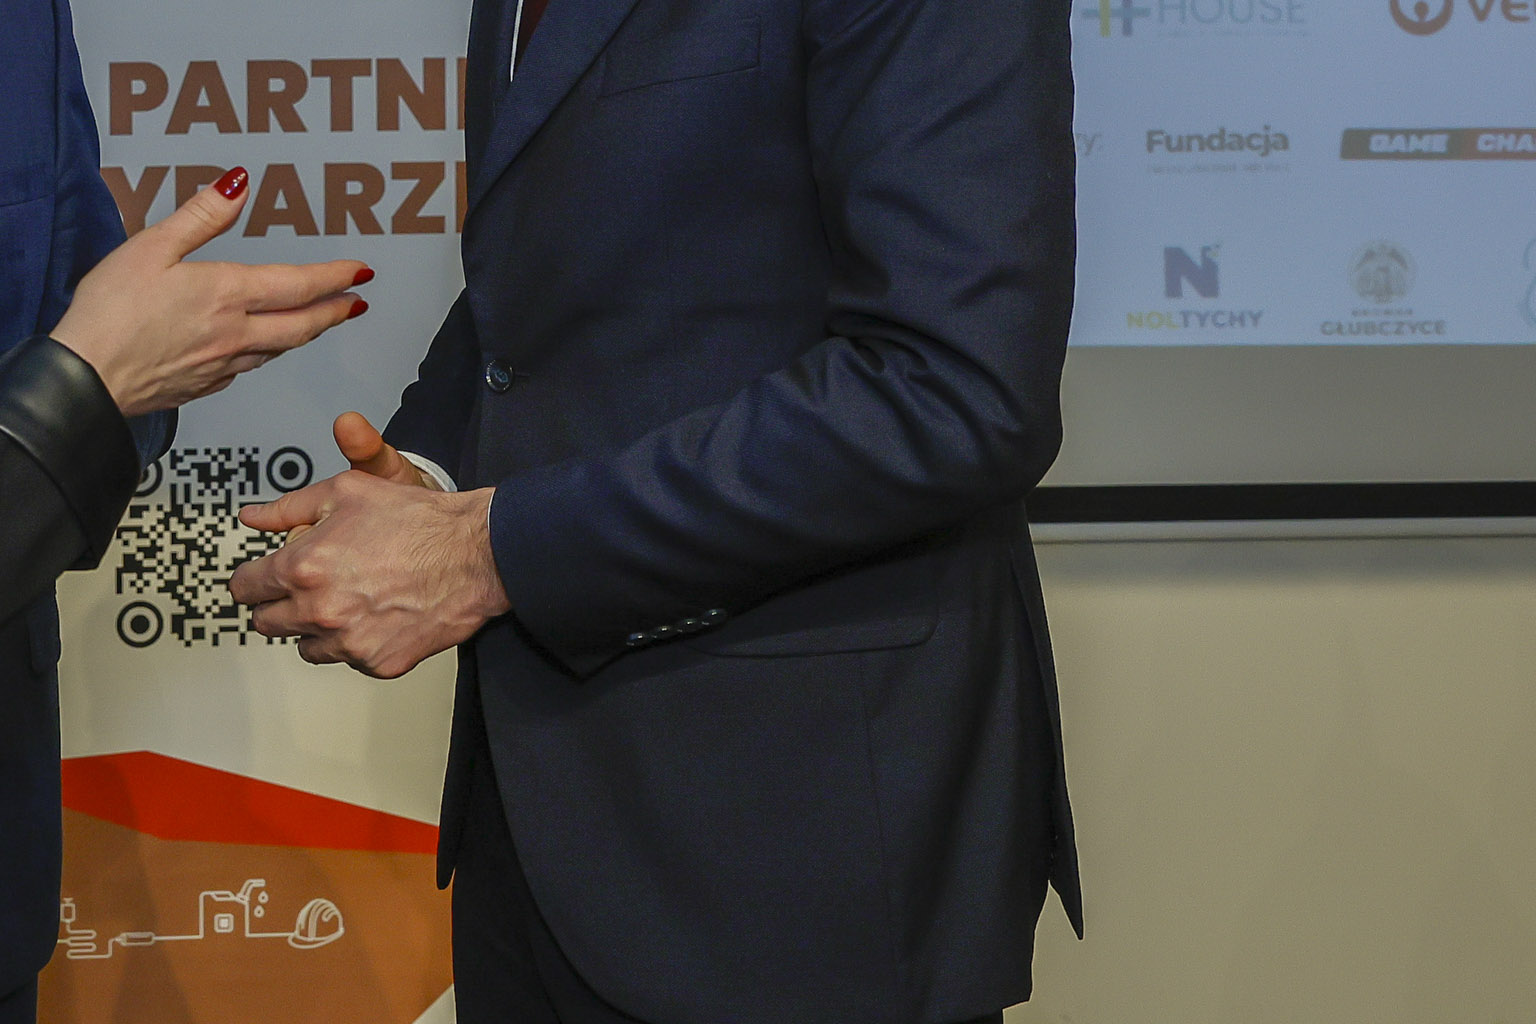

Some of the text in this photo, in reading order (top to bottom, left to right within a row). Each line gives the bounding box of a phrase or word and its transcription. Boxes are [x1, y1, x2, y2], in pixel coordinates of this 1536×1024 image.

[108, 57, 467, 136] PARTN
[1146, 124, 1290, 156] Fundacja
[1367, 133, 1449, 153] GAME
[1320, 319, 1448, 337] GŁUBCZYCE
